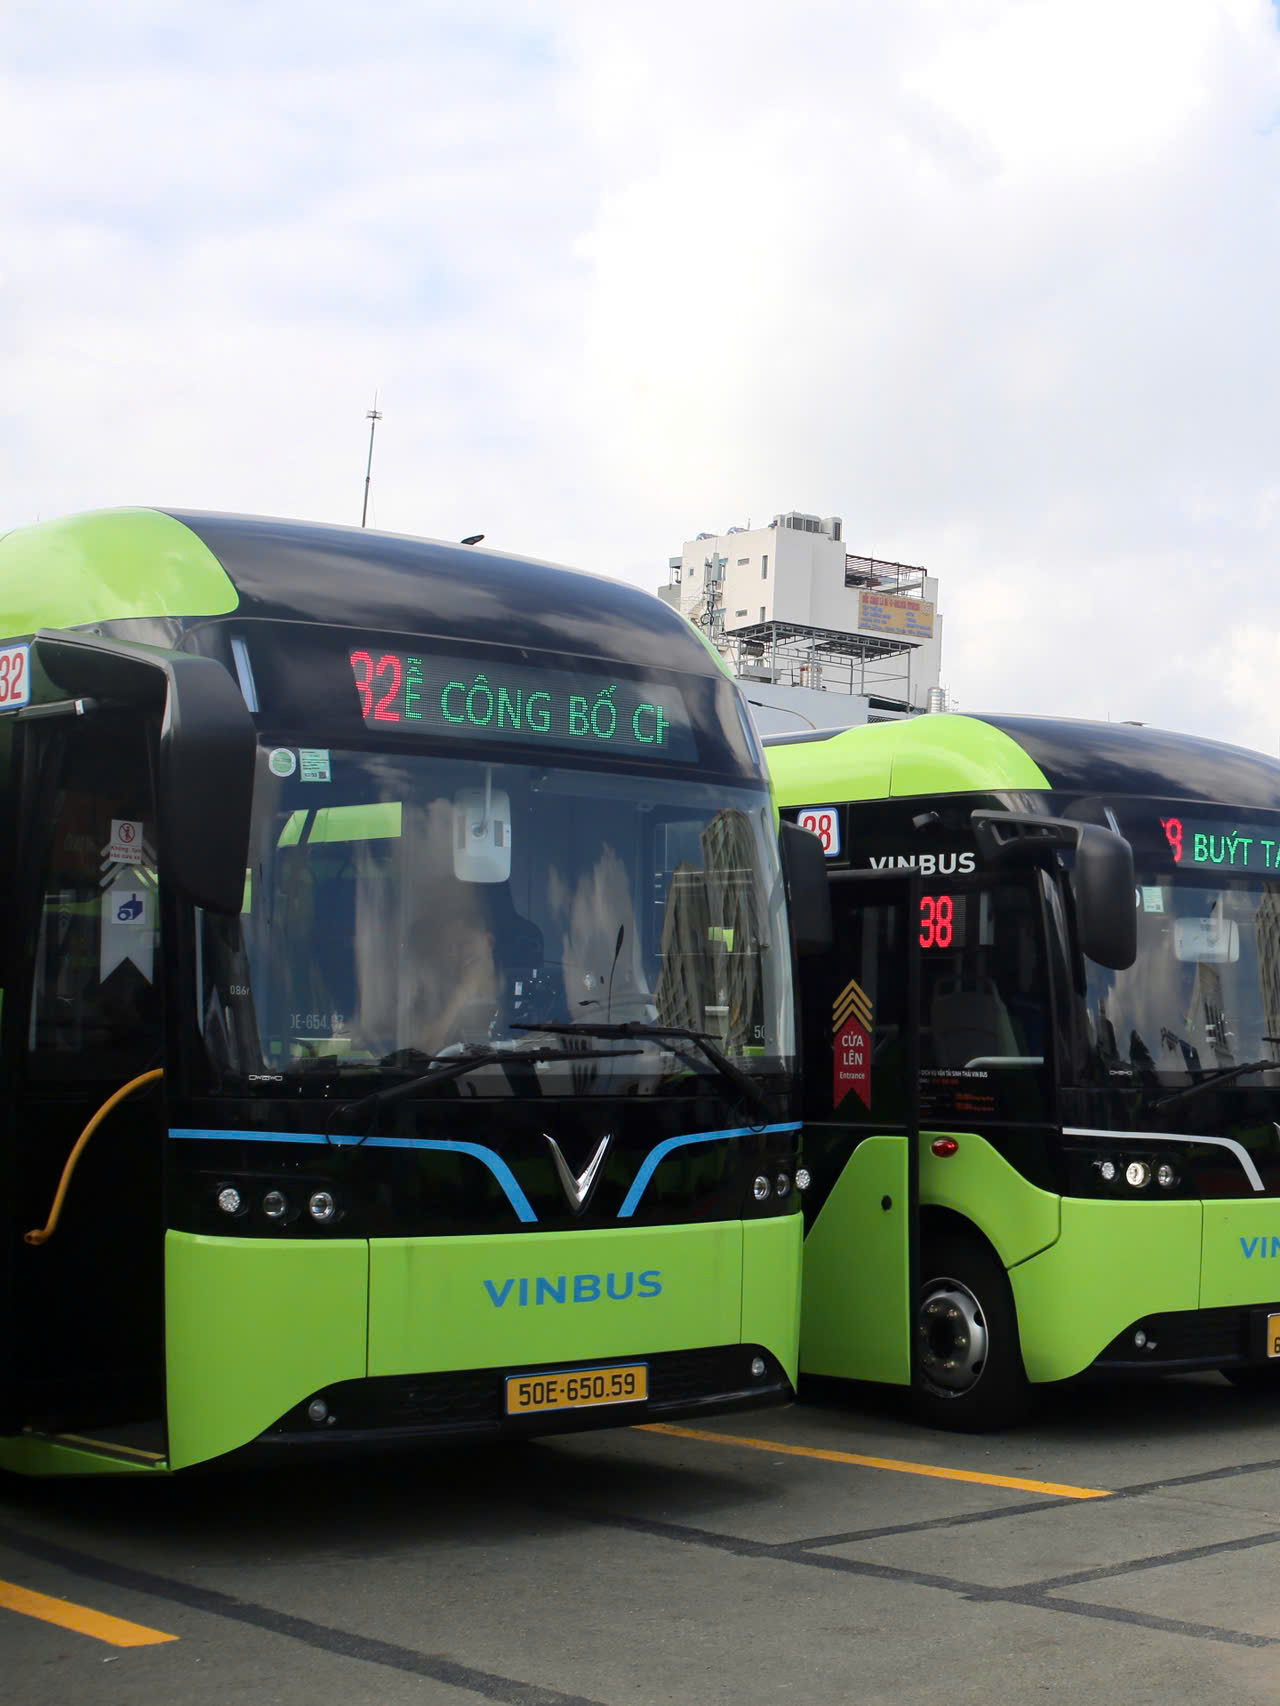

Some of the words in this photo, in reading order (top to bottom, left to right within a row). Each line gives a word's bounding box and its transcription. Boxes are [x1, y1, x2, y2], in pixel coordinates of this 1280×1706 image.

[0, 652, 25, 703] 32
[440, 673, 551, 733] CÔNG
[568, 683, 617, 740] BỐ
[869, 852, 976, 875] VINBUS
[1194, 830, 1253, 866] BUÝT
[919, 895, 953, 948] 38
[841, 1031, 864, 1047] CỬA
[843, 1049, 863, 1065] LÊN
[839, 1071, 866, 1080] Entrance
[483, 1270, 663, 1308] VINBUS
[519, 1373, 636, 1406] 50E-650.59
